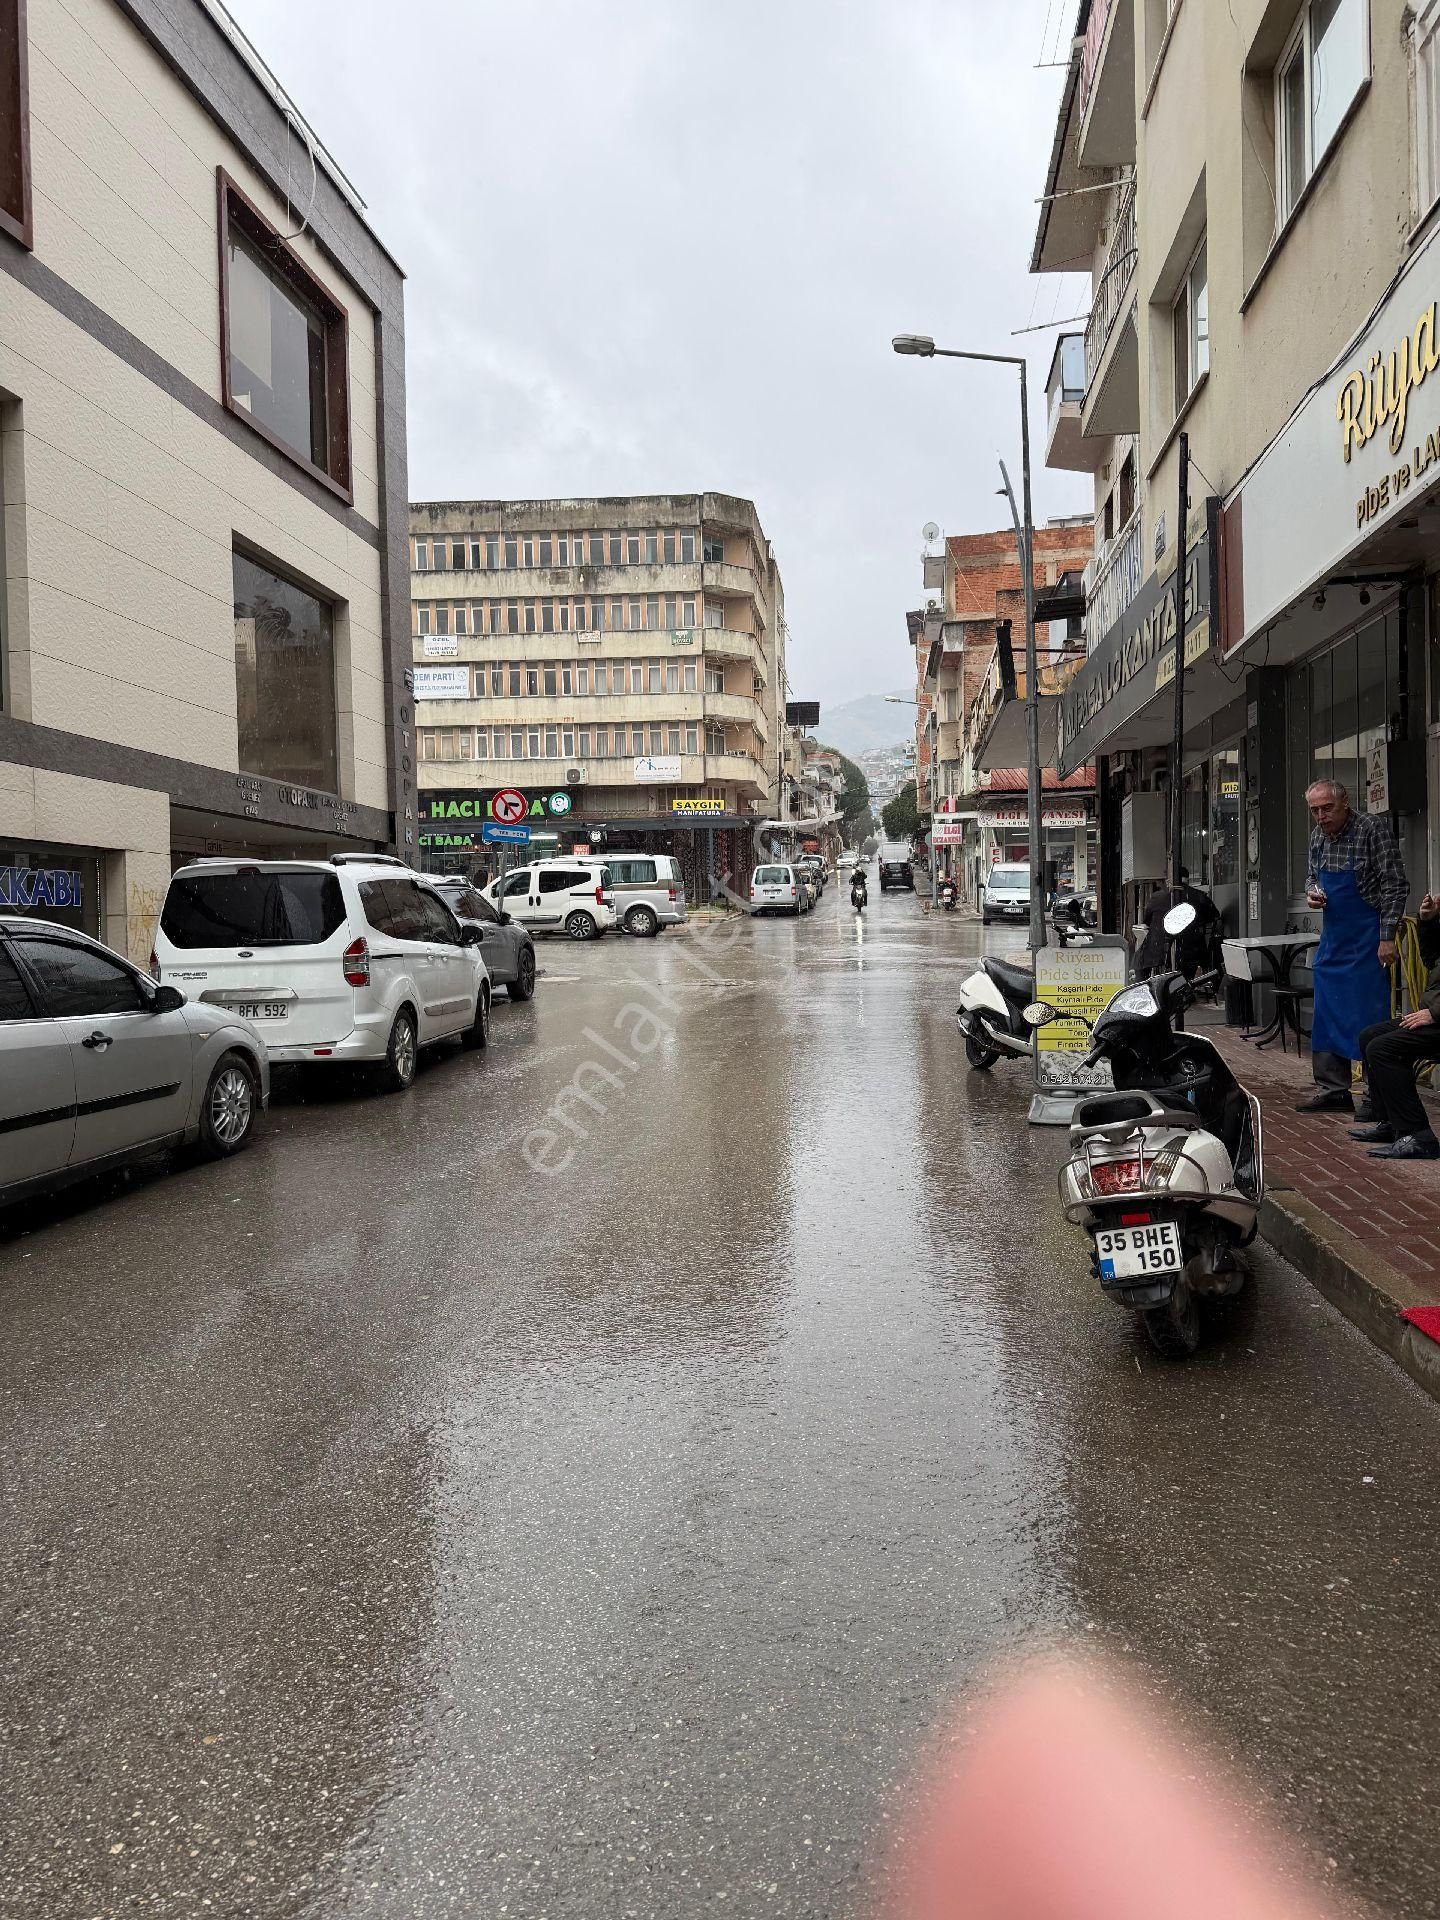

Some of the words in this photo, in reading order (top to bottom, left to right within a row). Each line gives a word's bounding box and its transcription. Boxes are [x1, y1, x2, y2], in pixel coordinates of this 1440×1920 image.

[1337, 302, 1440, 463] Rüya
[1357, 474, 1389, 528] PİDE
[1391, 464, 1410, 495] ve
[1107, 558, 1199, 703] LOKANTASI
[414, 673, 430, 681] DEM
[432, 670, 455, 681] PARTİ
[431, 800, 480, 818] HACI
[1055, 951, 1105, 966] Rüyam
[1040, 968, 1069, 981] Pide
[1073, 968, 1121, 981] Salonu
[1057, 985, 1084, 993] Kaşarlı
[240, 1005, 259, 1017] BFK
[265, 1004, 286, 1016] 592
[1100, 1232, 1127, 1253] 35
[1132, 1226, 1173, 1249] BHE
[1137, 1247, 1176, 1270] 150
